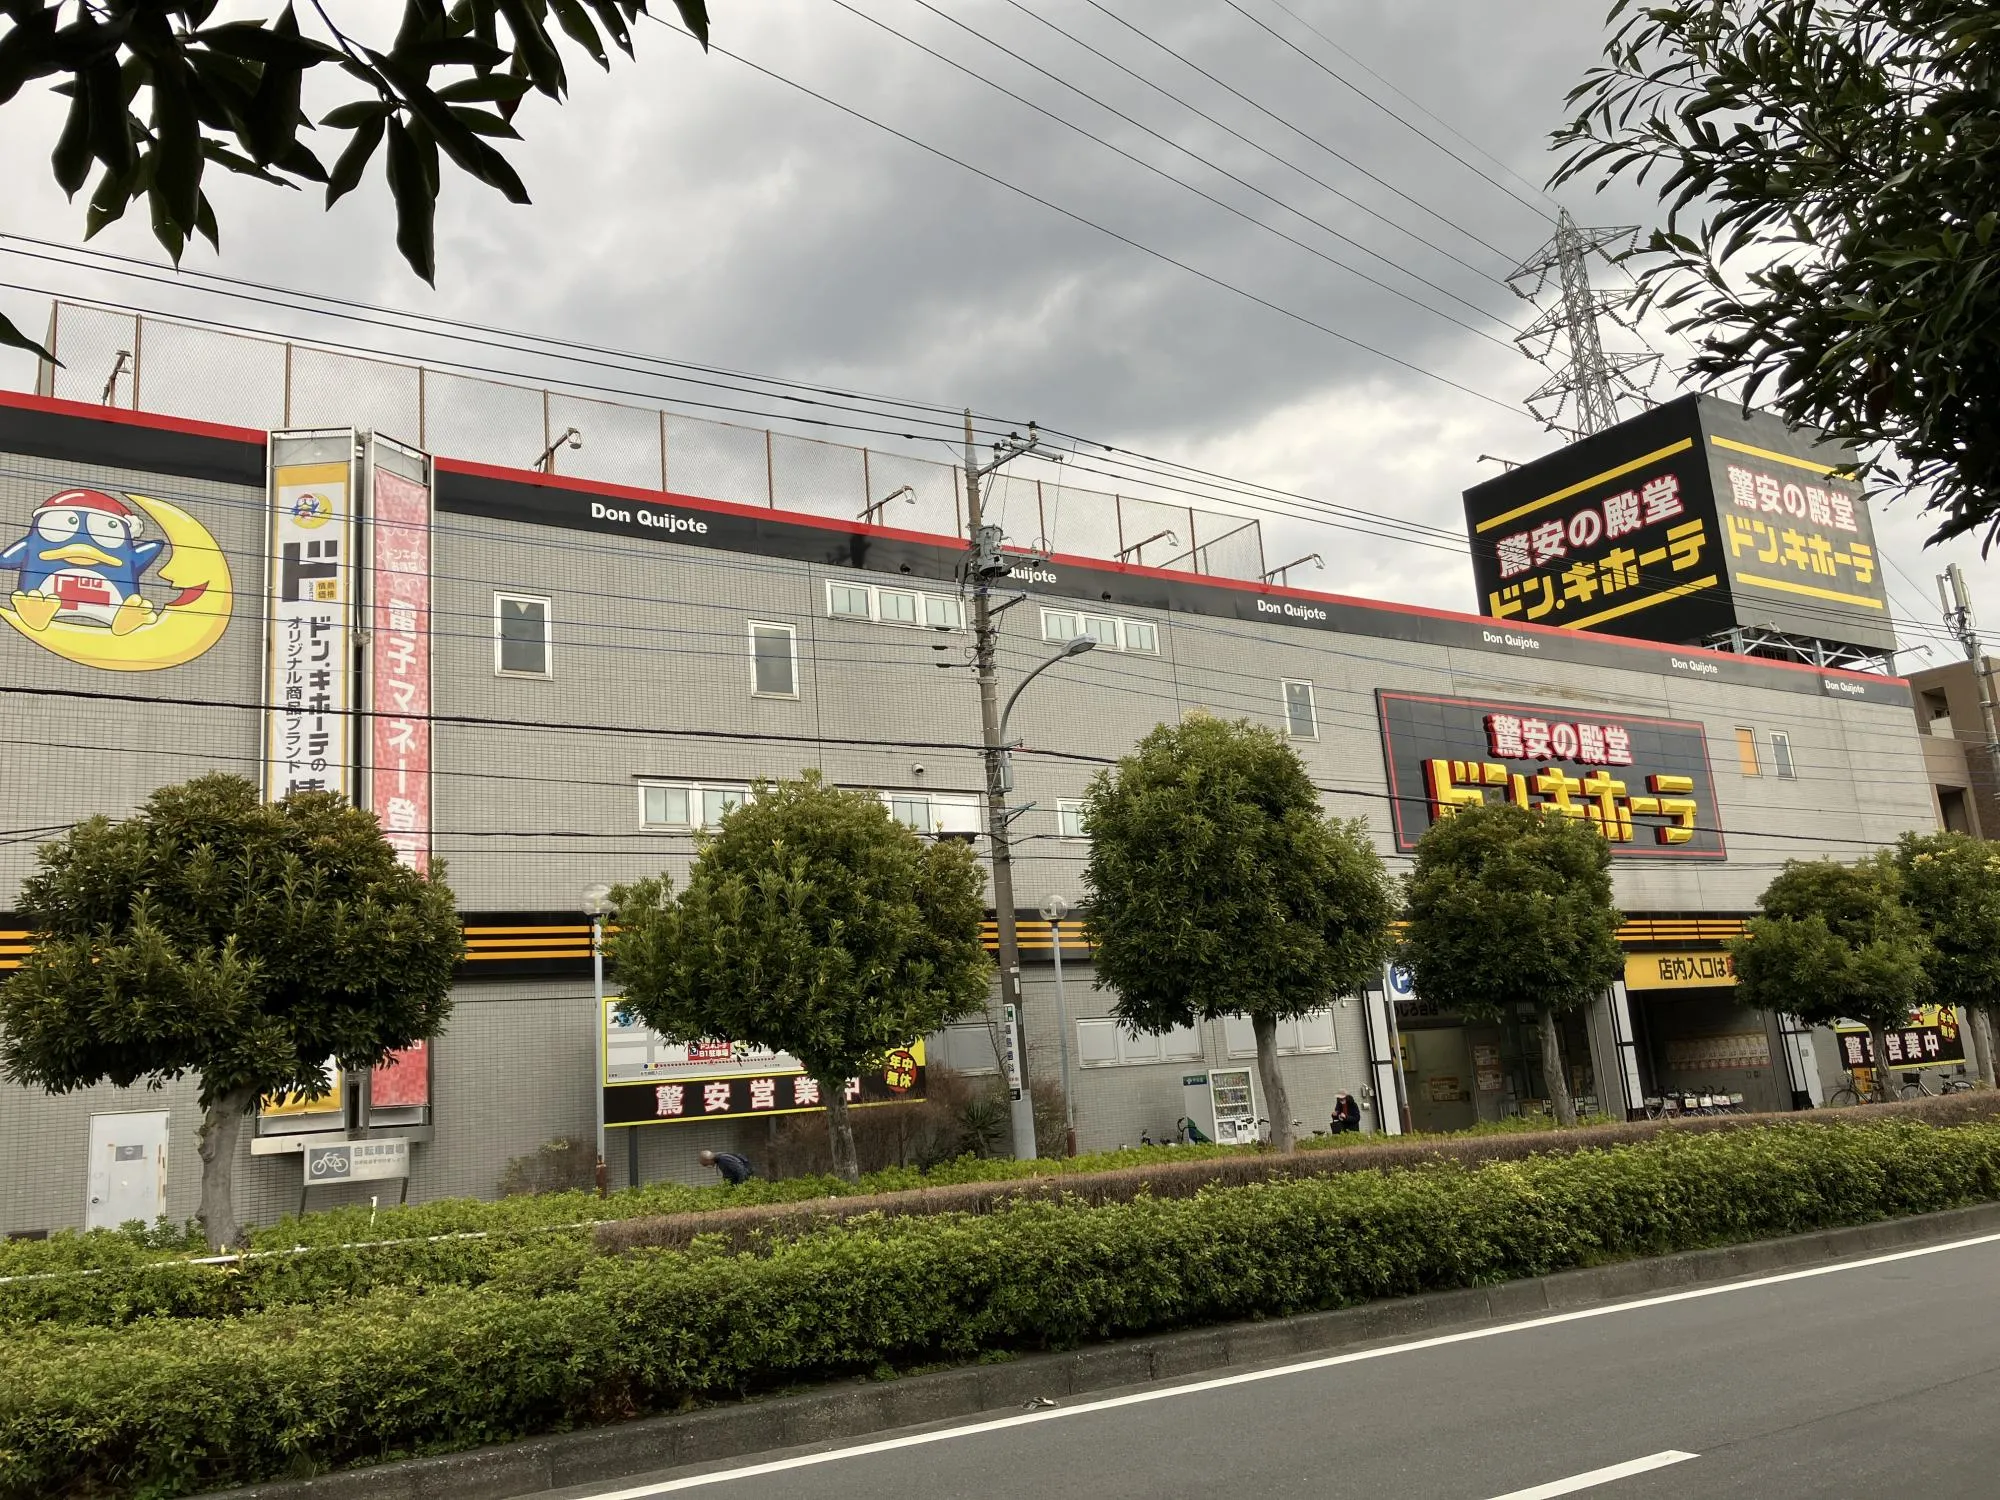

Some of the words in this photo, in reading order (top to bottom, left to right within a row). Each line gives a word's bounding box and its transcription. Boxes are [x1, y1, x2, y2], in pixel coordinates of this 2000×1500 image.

[1727, 465, 1857, 532] 驚安の殿堂
[591, 502, 631, 523] Don
[637, 509, 708, 534] Quijote
[1497, 474, 1684, 578] 驚安の殿堂
[282, 540, 337, 602] ド
[1257, 600, 1281, 614] Don
[1284, 604, 1327, 620] Quijote
[1483, 631, 1503, 644] Don
[1505, 634, 1540, 650] Quijote
[1671, 658, 1688, 669] Don
[1690, 661, 1718, 674] Quijote
[286, 616, 303, 774] オリジナル商品ブランド
[1825, 680, 1839, 690] Don
[1840, 682, 1865, 694] Quijote
[1490, 713, 1633, 765] 驚安の殿堂
[887, 1070, 912, 1088] 無休
[890, 1055, 913, 1071] 年中
[655, 1076, 860, 1116] 驚安営業中
